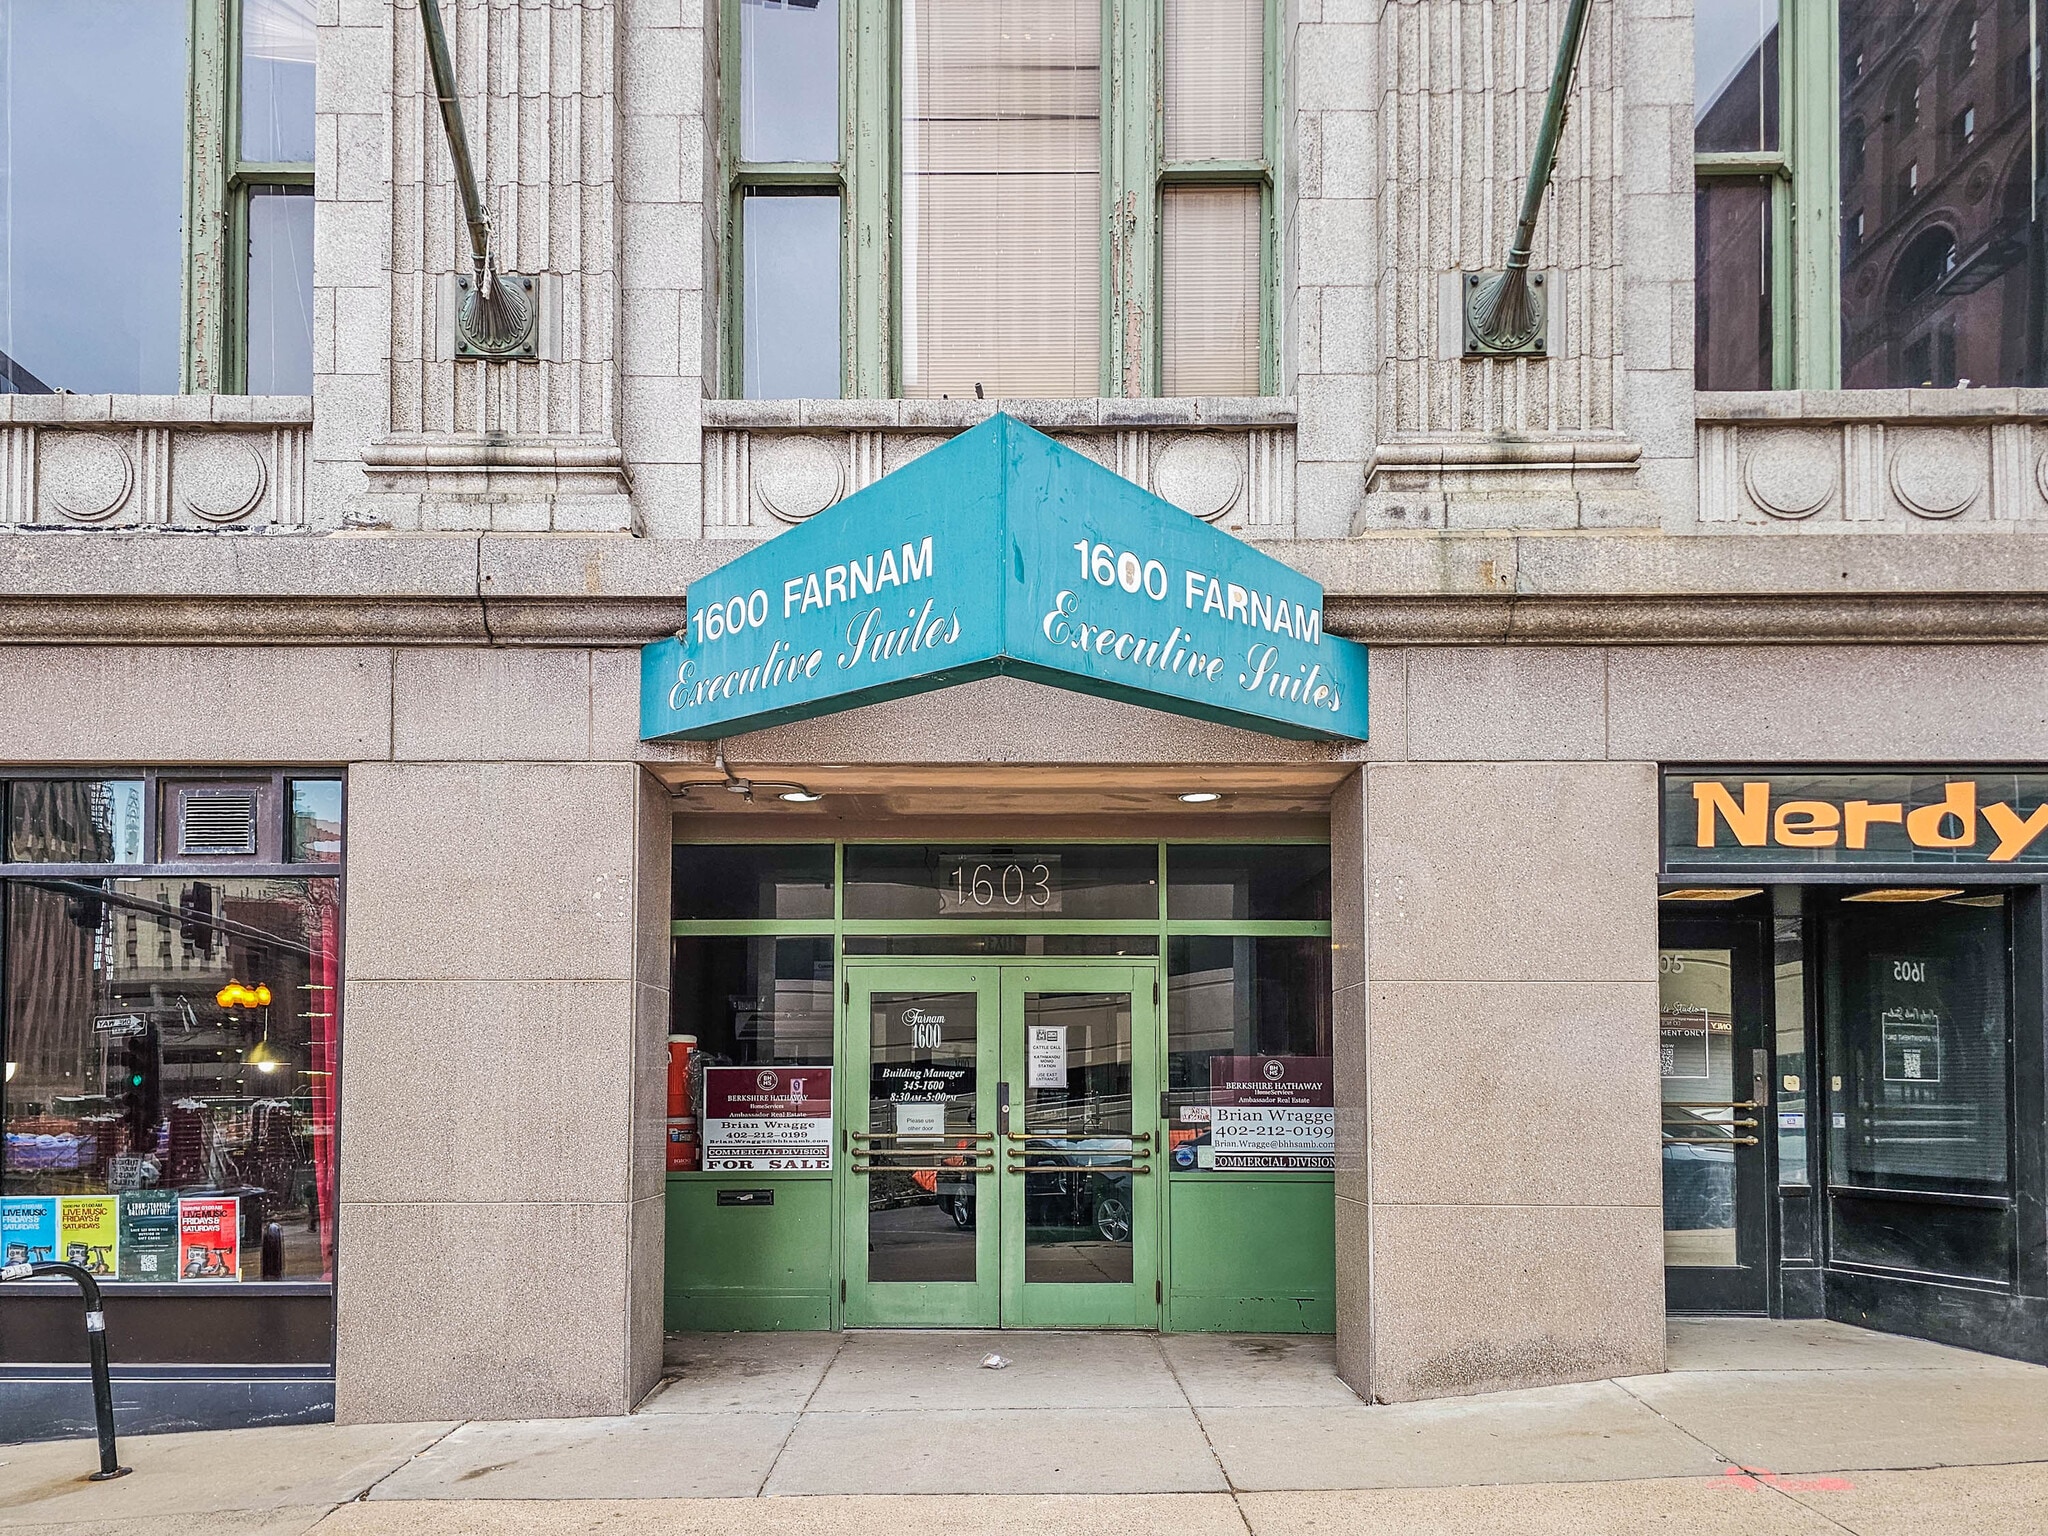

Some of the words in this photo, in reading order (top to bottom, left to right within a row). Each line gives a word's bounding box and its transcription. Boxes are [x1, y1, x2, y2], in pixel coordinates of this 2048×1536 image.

[691, 587, 768, 644] 1600
[783, 535, 933, 619] FARNAM
[1074, 538, 1168, 601] 1600
[1185, 569, 1321, 646] FARNAM
[668, 640, 823, 711] Executive
[837, 597, 962, 670] Suites
[1042, 589, 1226, 683] Executive
[1239, 642, 1344, 713] Suites
[1693, 781, 2048, 861] Nerdy
[951, 864, 1051, 906] 1603
[1672, 1001, 1699, 1016] Studio
[901, 1008, 945, 1027] Farnam
[912, 1024, 941, 1049] 1600
[882, 1068, 921, 1080] Building
[923, 1068, 965, 1080] Manager
[902, 1080, 945, 1091] 345-1600
[1226, 1082, 1274, 1090] BERKSHIRE
[1275, 1082, 1323, 1090] HATHAWAY
[770, 1094, 808, 1102] HATHAWAY
[1217, 1108, 1263, 1122] Brian
[1268, 1109, 1333, 1125] Wragge
[721, 1121, 759, 1129] Brian
[764, 1121, 815, 1130] Wragge
[726, 1131, 808, 1139] 402-212-0199
[1216, 1125, 1334, 1139] 402-212-0199
[1214, 1140, 1335, 1150] Brian.Wragge@bhhsamb.com
[708, 1148, 780, 1156] COMMERCIAL
[781, 1148, 827, 1156] DIVISION
[707, 1160, 754, 1169] FOR
[769, 1160, 830, 1169] SALE
[1215, 1157, 1287, 1167] COMMERCIAL
[1288, 1157, 1335, 1167] DIVISION
[22, 1208, 48, 1216] MUSIC
[62, 1208, 81, 1216] LIVE
[82, 1208, 108, 1216] MUSIC
[182, 1210, 200, 1218] LIVE
[182, 1217, 214, 1225] FRIDAYS
